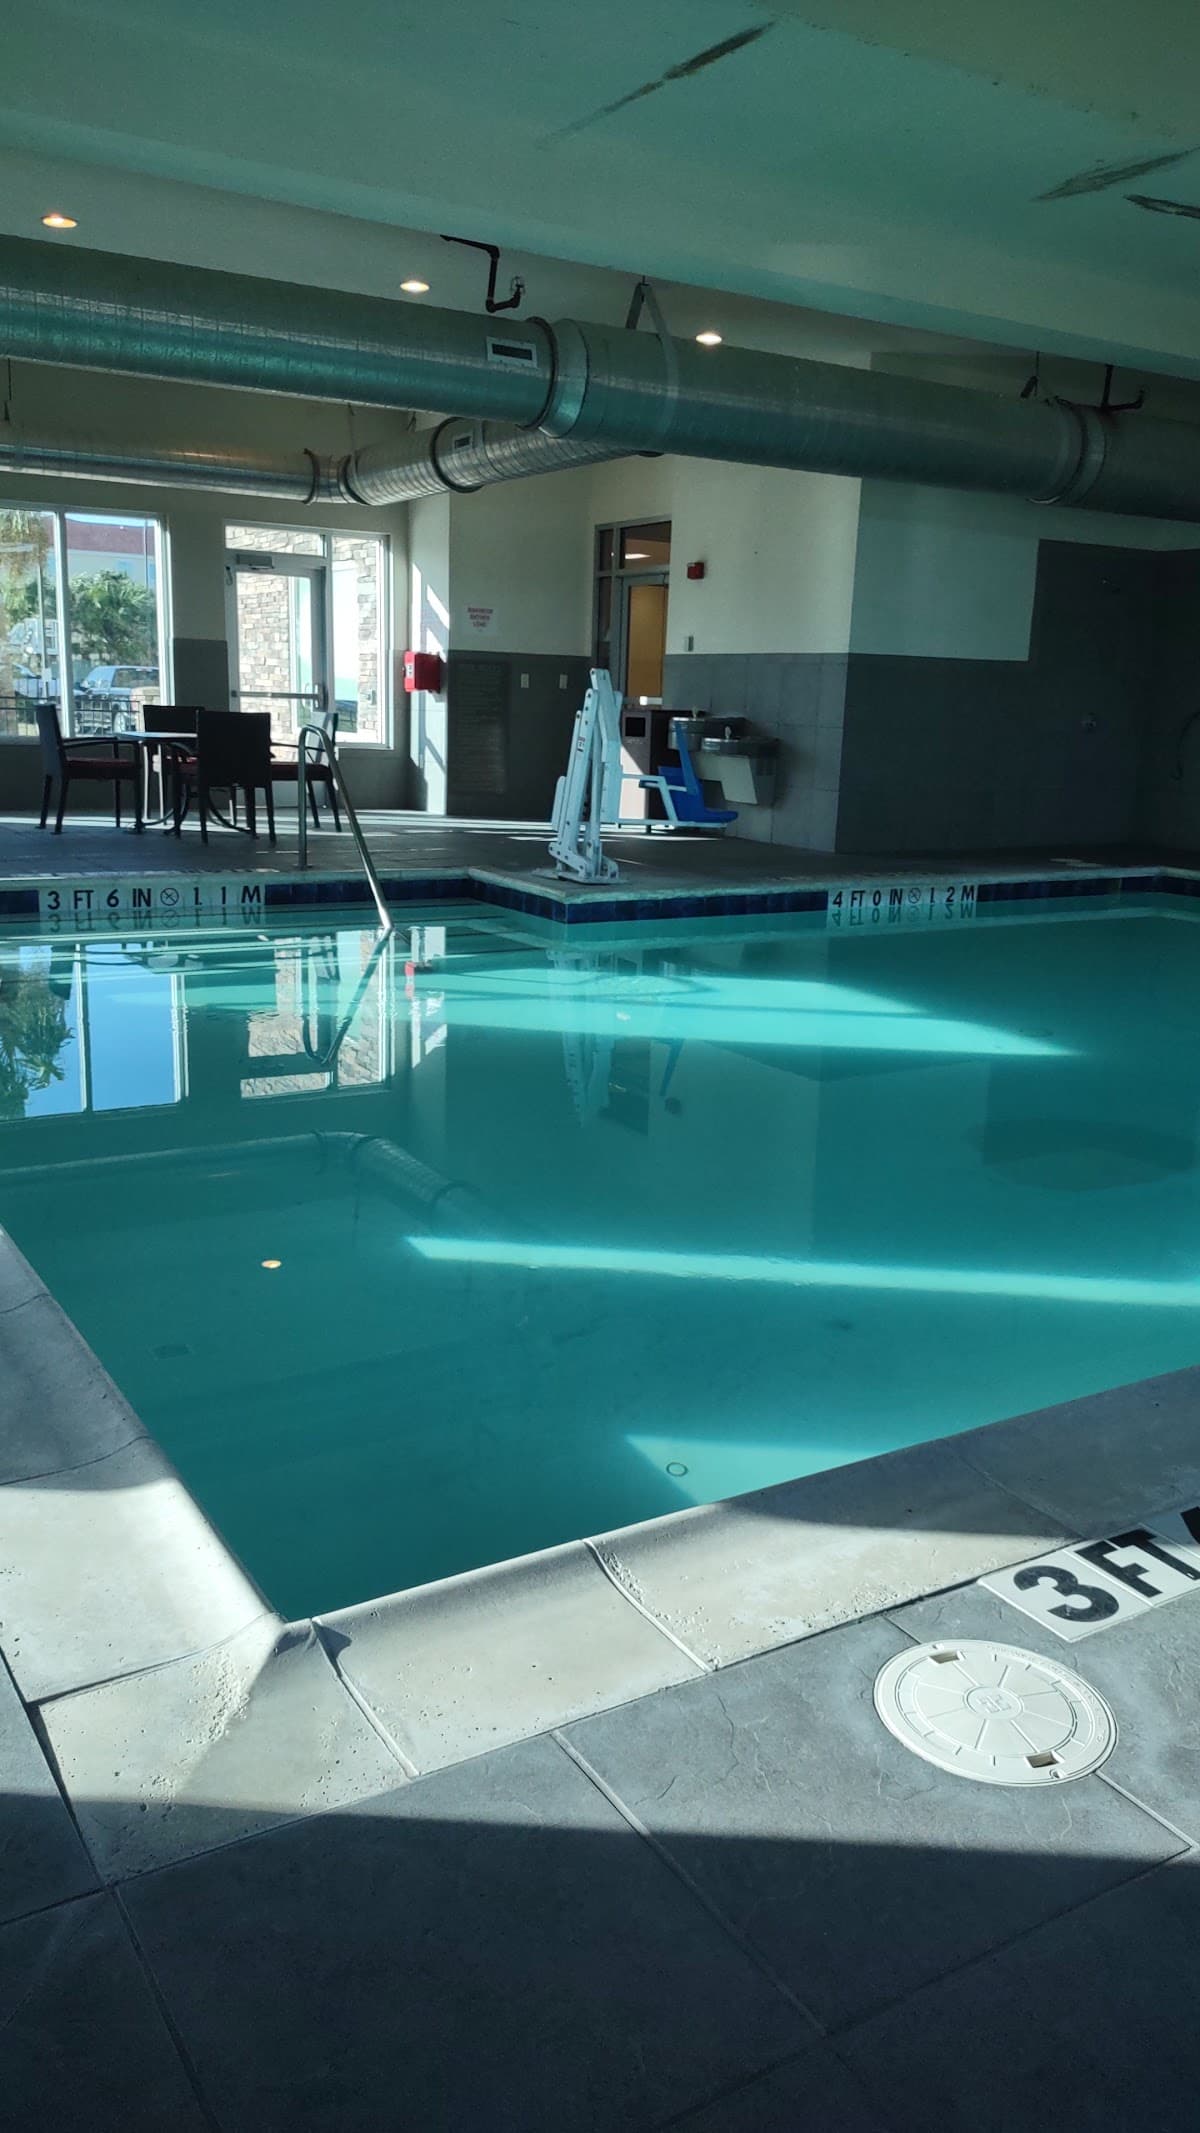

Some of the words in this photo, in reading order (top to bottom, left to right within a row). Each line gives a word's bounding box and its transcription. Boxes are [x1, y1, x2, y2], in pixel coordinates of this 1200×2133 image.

[47, 890, 60, 910] 3
[74, 889, 94, 909] FT
[107, 888, 119, 907] 6
[132, 887, 151, 907] IN
[241, 885, 261, 903] M
[833, 891, 842, 907] 4
[851, 889, 865, 907] FT
[890, 888, 903, 905] IN
[961, 885, 974, 901] M
[1013, 1566, 1119, 1622] 3
[1074, 1529, 1200, 1598] FT
